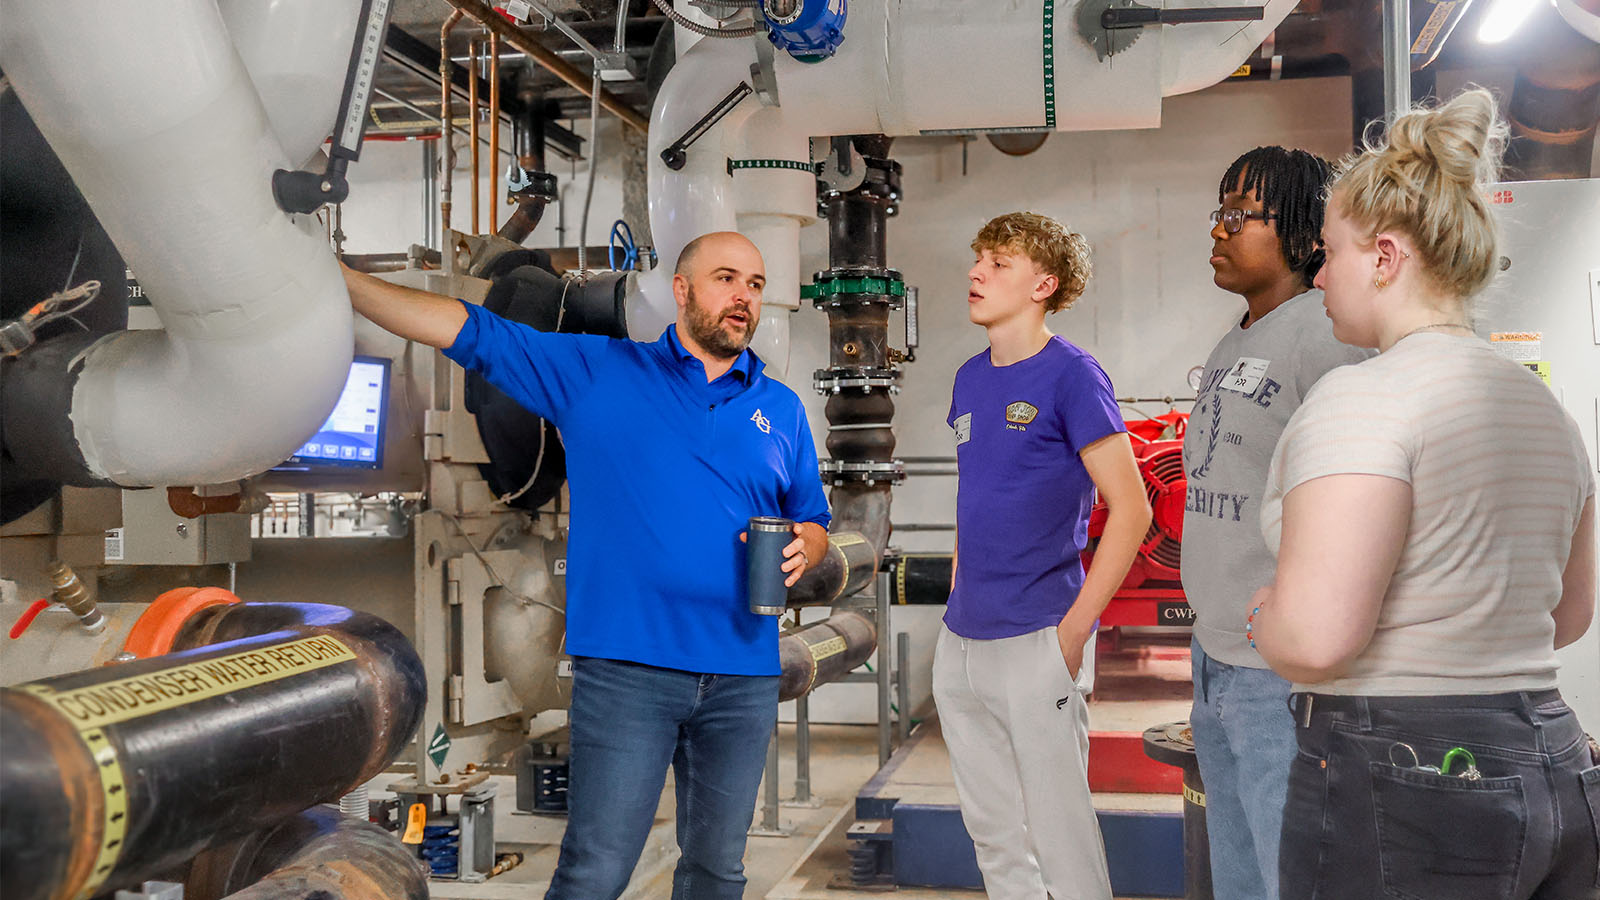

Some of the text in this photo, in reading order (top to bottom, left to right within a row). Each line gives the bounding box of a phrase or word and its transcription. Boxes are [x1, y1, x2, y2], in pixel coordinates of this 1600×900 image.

[57, 637, 347, 720] CONDENSER WATER RETURN
